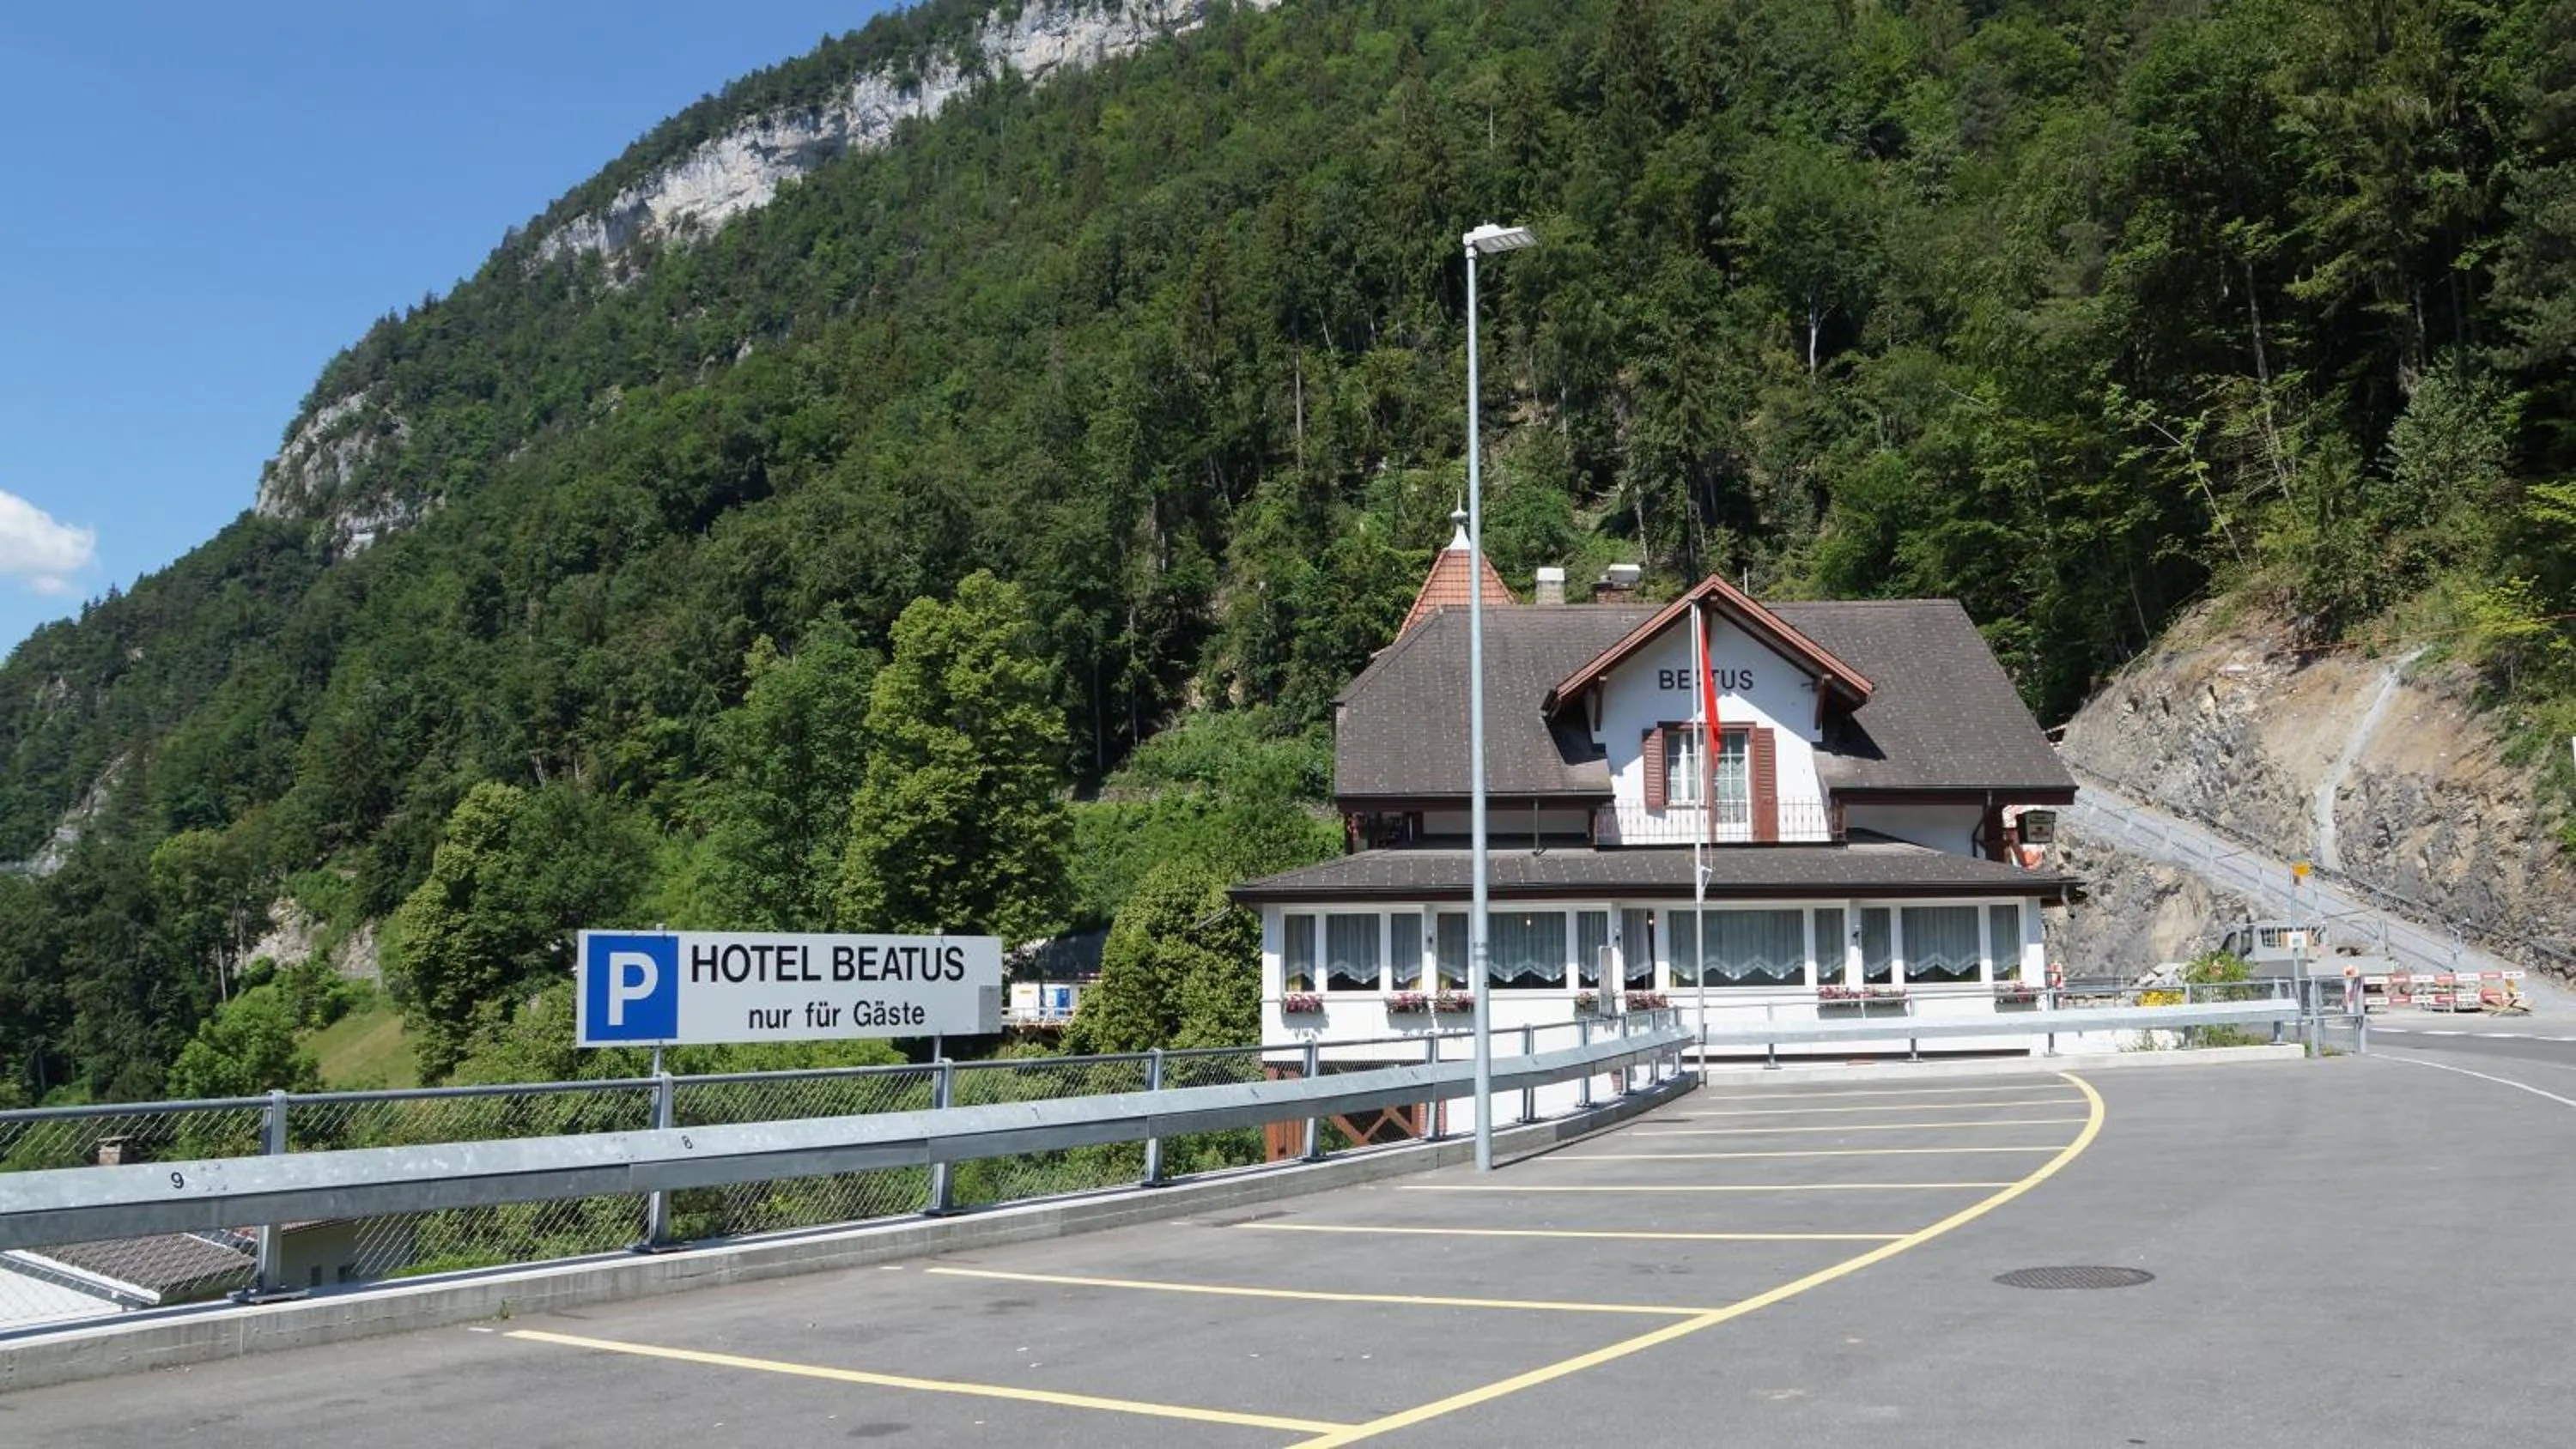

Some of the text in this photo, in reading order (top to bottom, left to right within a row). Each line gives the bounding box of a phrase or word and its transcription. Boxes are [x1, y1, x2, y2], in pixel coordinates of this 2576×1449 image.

[1658, 669, 1754, 690] BETUS
[691, 943, 965, 983] HOTEL BEATUS
[608, 951, 659, 1026] P
[748, 999, 926, 1029] nur für Gäste
[681, 1135, 693, 1149] 8
[171, 1172, 184, 1189] 9
